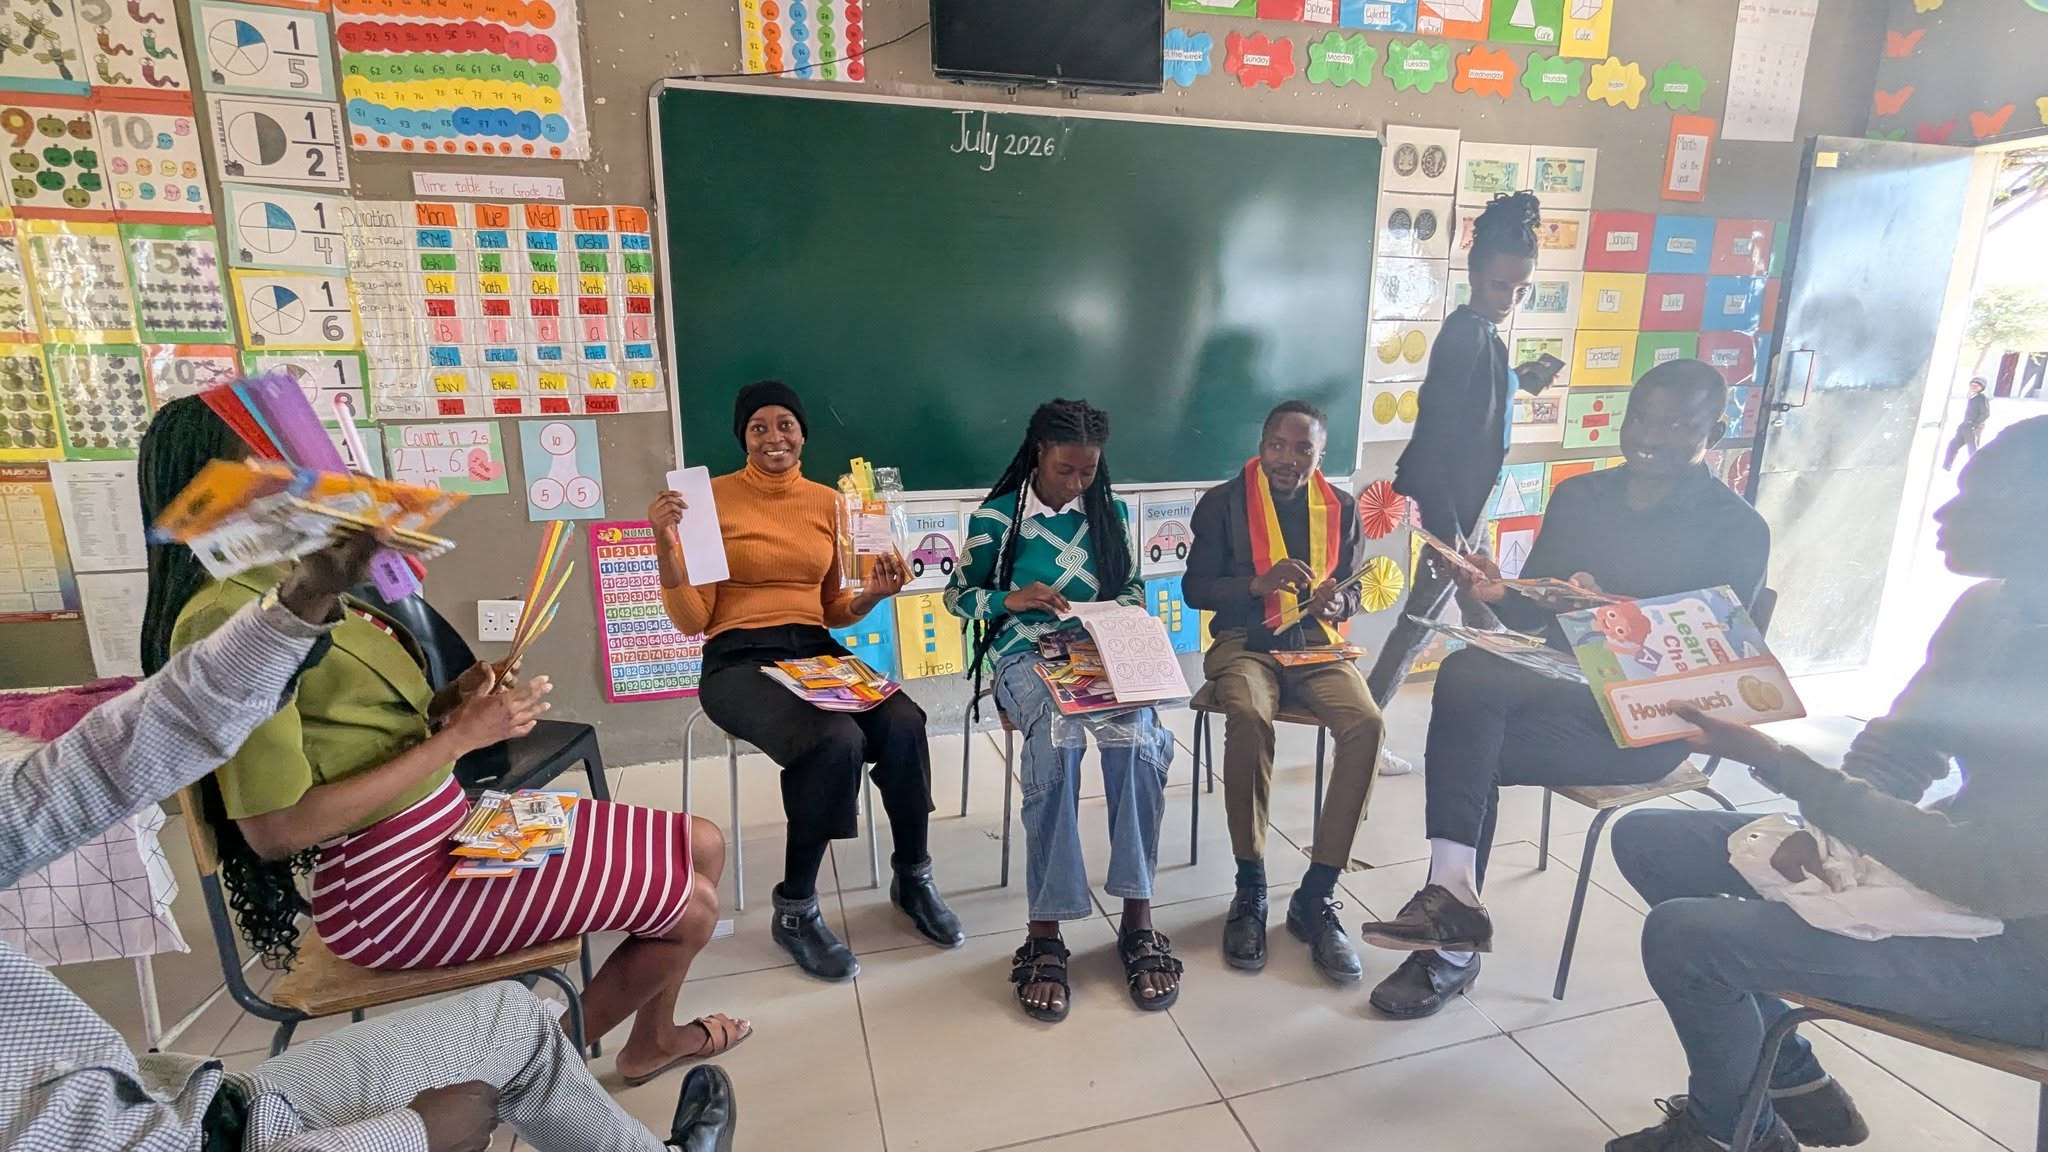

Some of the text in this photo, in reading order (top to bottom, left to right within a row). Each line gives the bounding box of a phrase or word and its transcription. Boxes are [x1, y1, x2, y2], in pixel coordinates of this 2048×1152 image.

[1306, 3, 1331, 20] Sphere
[747, 21, 755, 29] 72
[287, 21, 299, 50] 1
[1536, 27, 1553, 40] Cone
[1575, 28, 1591, 40] Cube
[1171, 50, 1182, 58] the
[1245, 55, 1269, 65] Sunday
[1327, 54, 1353, 62] Monday
[749, 60, 757, 69] 92
[1405, 61, 1429, 69] Tuesday
[289, 58, 309, 88] 5
[370, 63, 549, 82] 62 66 69 70
[1470, 70, 1503, 79] Wednesday
[1543, 75, 1567, 83] Thursday
[1608, 81, 1624, 89] Friday
[0, 107, 34, 147] 9
[304, 111, 316, 139] 1
[102, 115, 154, 150] 10
[950, 110, 1056, 172] July 2026
[306, 148, 326, 177] 2
[415, 173, 446, 194] Time
[455, 177, 480, 194] table
[488, 181, 504, 195] for
[513, 183, 539, 197] Grade
[313, 202, 325, 229] 1
[340, 206, 396, 227] Duration
[417, 204, 446, 226] Mon
[526, 205, 555, 228] Wed
[574, 208, 607, 230] Thur
[617, 209, 635, 231] Fri
[421, 232, 448, 247] RME
[527, 237, 553, 250] Math
[576, 234, 602, 250] Oshi
[621, 236, 648, 249] RME
[314, 236, 332, 264] 4
[421, 257, 441, 270] Oshi
[533, 262, 555, 272] Math
[580, 261, 600, 272] Oshi
[625, 258, 647, 273] Oshi
[322, 280, 334, 306] 1
[425, 278, 646, 294] Oshi Math Oshi Math Oshi
[321, 315, 344, 341] 6
[440, 321, 643, 342] B r e a k
[333, 359, 345, 384] 1
[434, 378, 459, 392] ENV
[492, 379, 512, 390] ENG
[539, 378, 557, 390] ENV
[595, 378, 608, 389] Art
[404, 426, 489, 447] Count in 2s
[552, 436, 561, 446] 10
[0, 484, 34, 494] 026
[541, 487, 586, 502] 5 5
[1147, 505, 1191, 519] Seventh
[916, 519, 945, 529] Third
[623, 529, 655, 537] NUMB
[602, 564, 612, 572] 11
[615, 563, 626, 571] 12
[642, 562, 652, 570] 14
[604, 577, 654, 587] 21 22 23 24
[605, 594, 615, 602] 31
[919, 595, 932, 608] 3
[633, 608, 644, 616] 43
[646, 607, 657, 615] 44
[609, 624, 618, 632] 51
[622, 623, 632, 631] 52
[648, 622, 658, 630] 54
[661, 621, 672, 629] 55
[610, 639, 620, 647] 61
[612, 648, 700, 662] 71 72 73 74 75 76 77
[613, 669, 623, 677] 81
[626, 668, 636, 676] 82
[639, 667, 650, 675] 83
[652, 666, 663, 674] 84
[917, 661, 953, 678] three
[615, 683, 625, 691] 91
[628, 682, 638, 690] 92
[641, 681, 651, 689] 93
[654, 680, 664, 688] 94
[666, 679, 677, 687] 95
[1627, 690, 1733, 722] How uch
